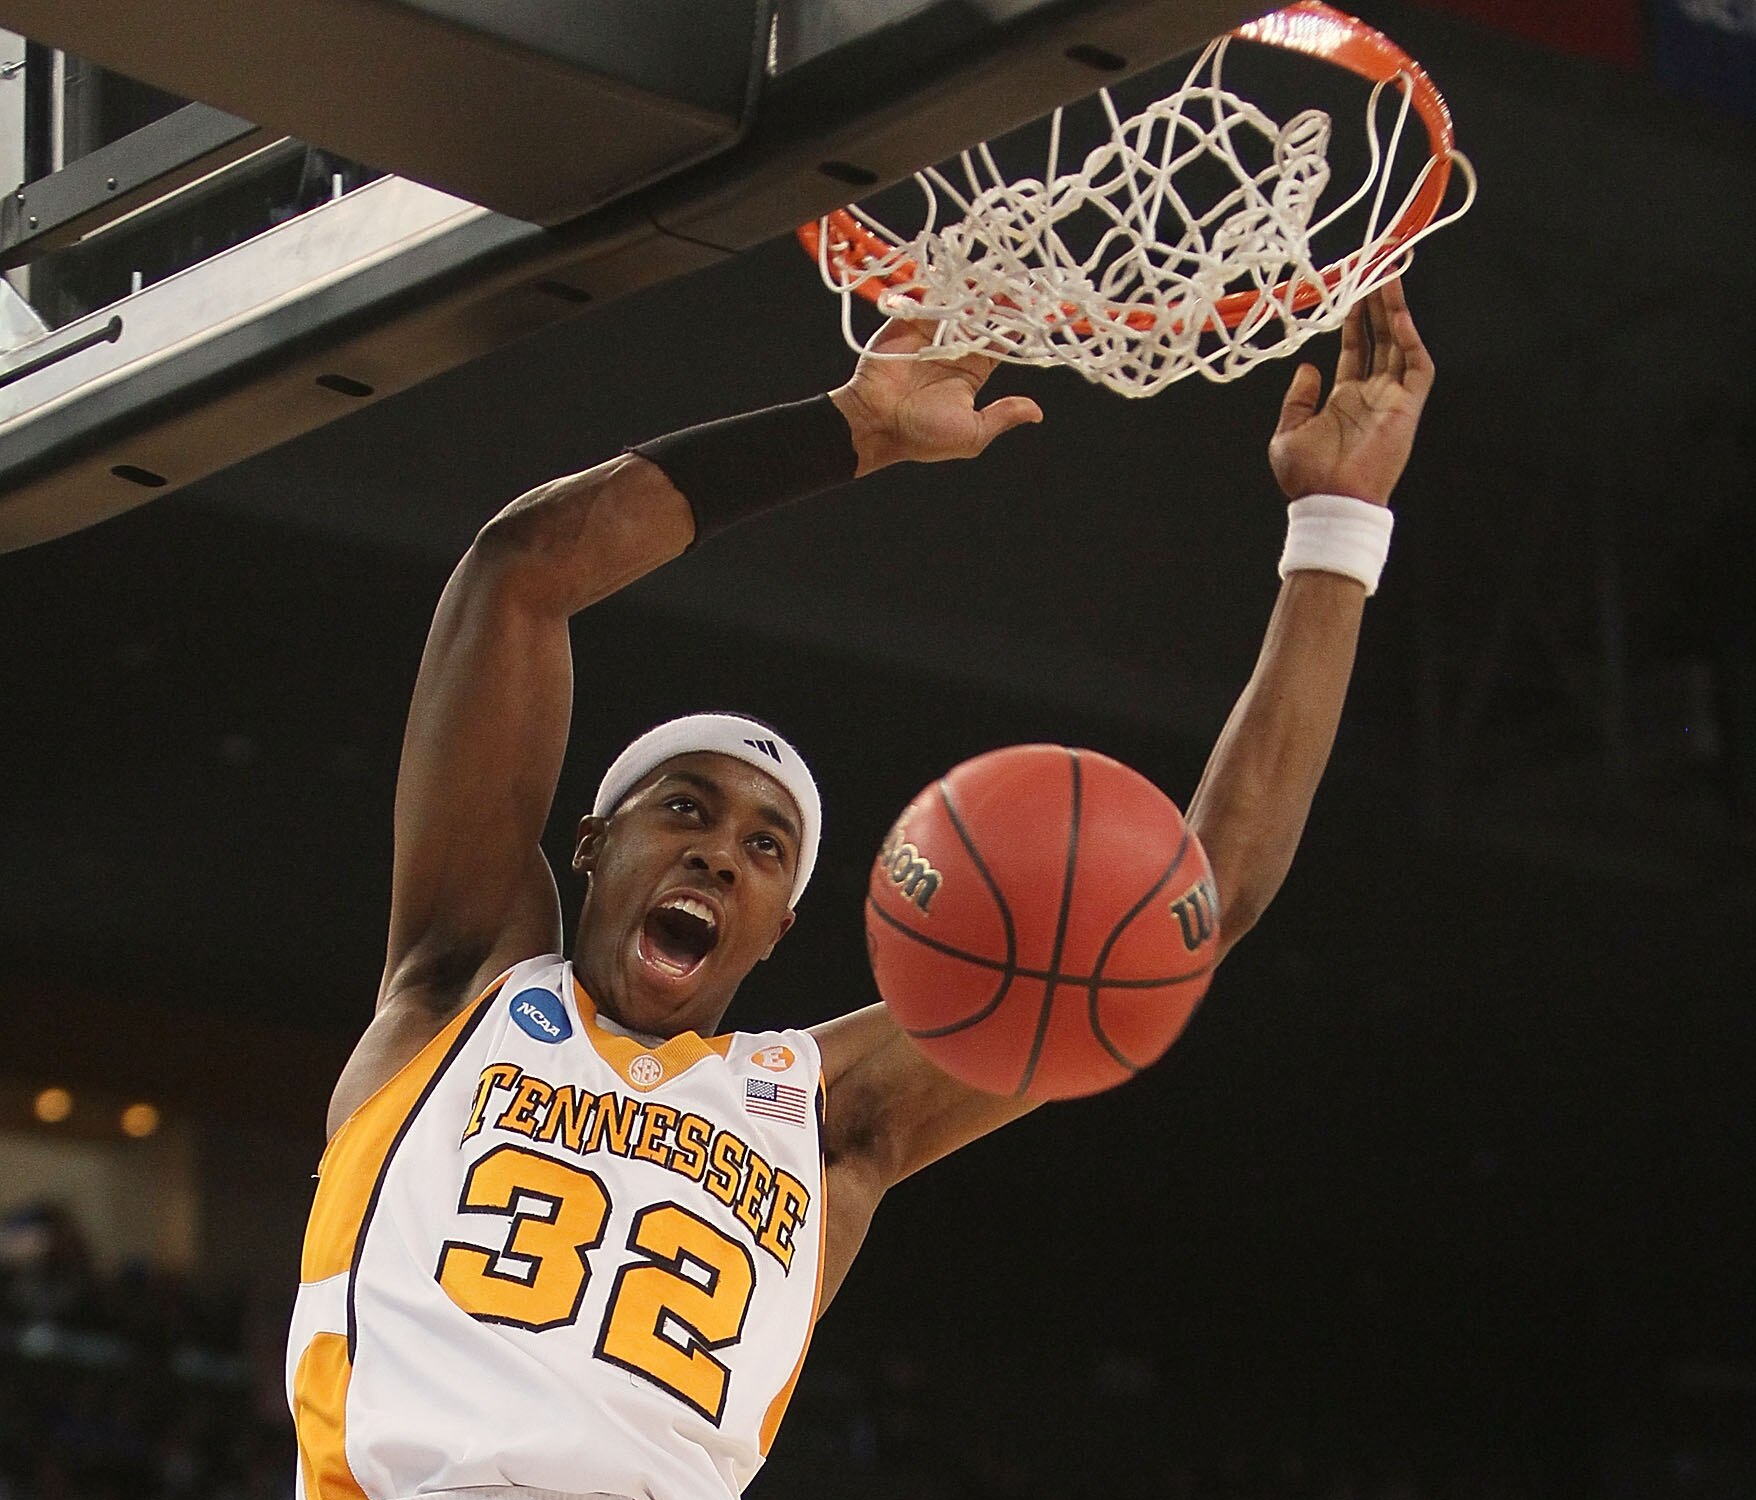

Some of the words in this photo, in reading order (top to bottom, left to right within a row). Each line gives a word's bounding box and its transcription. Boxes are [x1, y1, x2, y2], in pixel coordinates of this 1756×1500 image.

[516, 1001, 561, 1037] NCAA
[631, 1058, 661, 1084] SEC
[763, 1047, 787, 1068] E
[460, 1063, 811, 1277] TENNESSEE
[434, 1142, 757, 1429] 32
